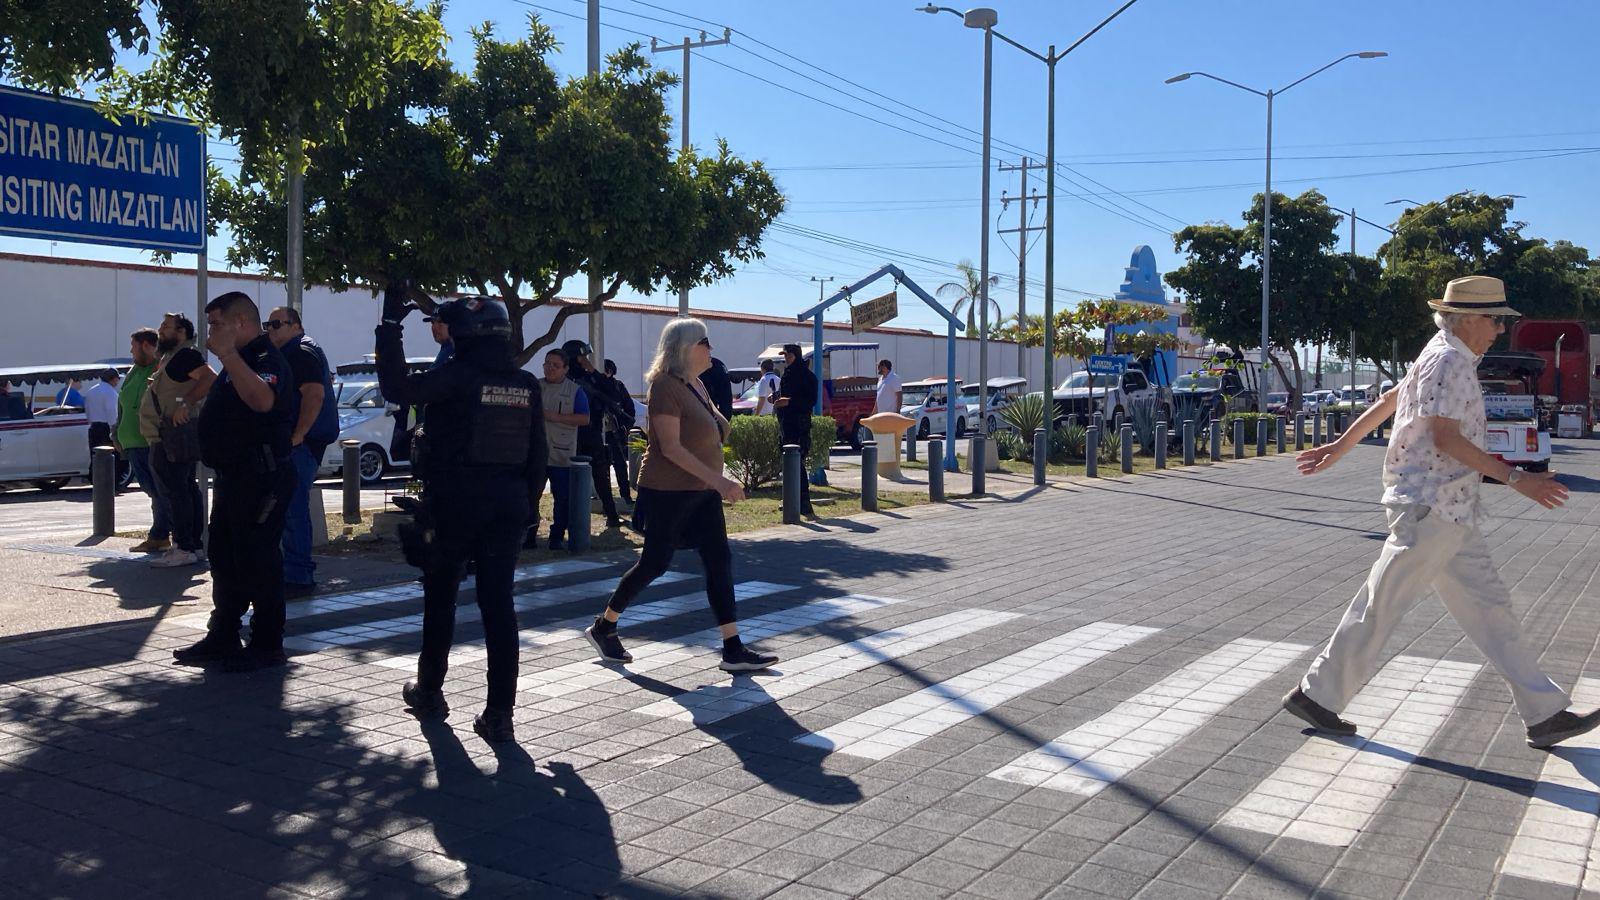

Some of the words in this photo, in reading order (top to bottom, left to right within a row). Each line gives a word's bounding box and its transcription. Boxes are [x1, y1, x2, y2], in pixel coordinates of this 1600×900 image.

[67, 127, 179, 178] MAZATLÁN
[89, 186, 198, 233] MAZATLAN
[481, 394, 529, 406] MUNICIPAL
